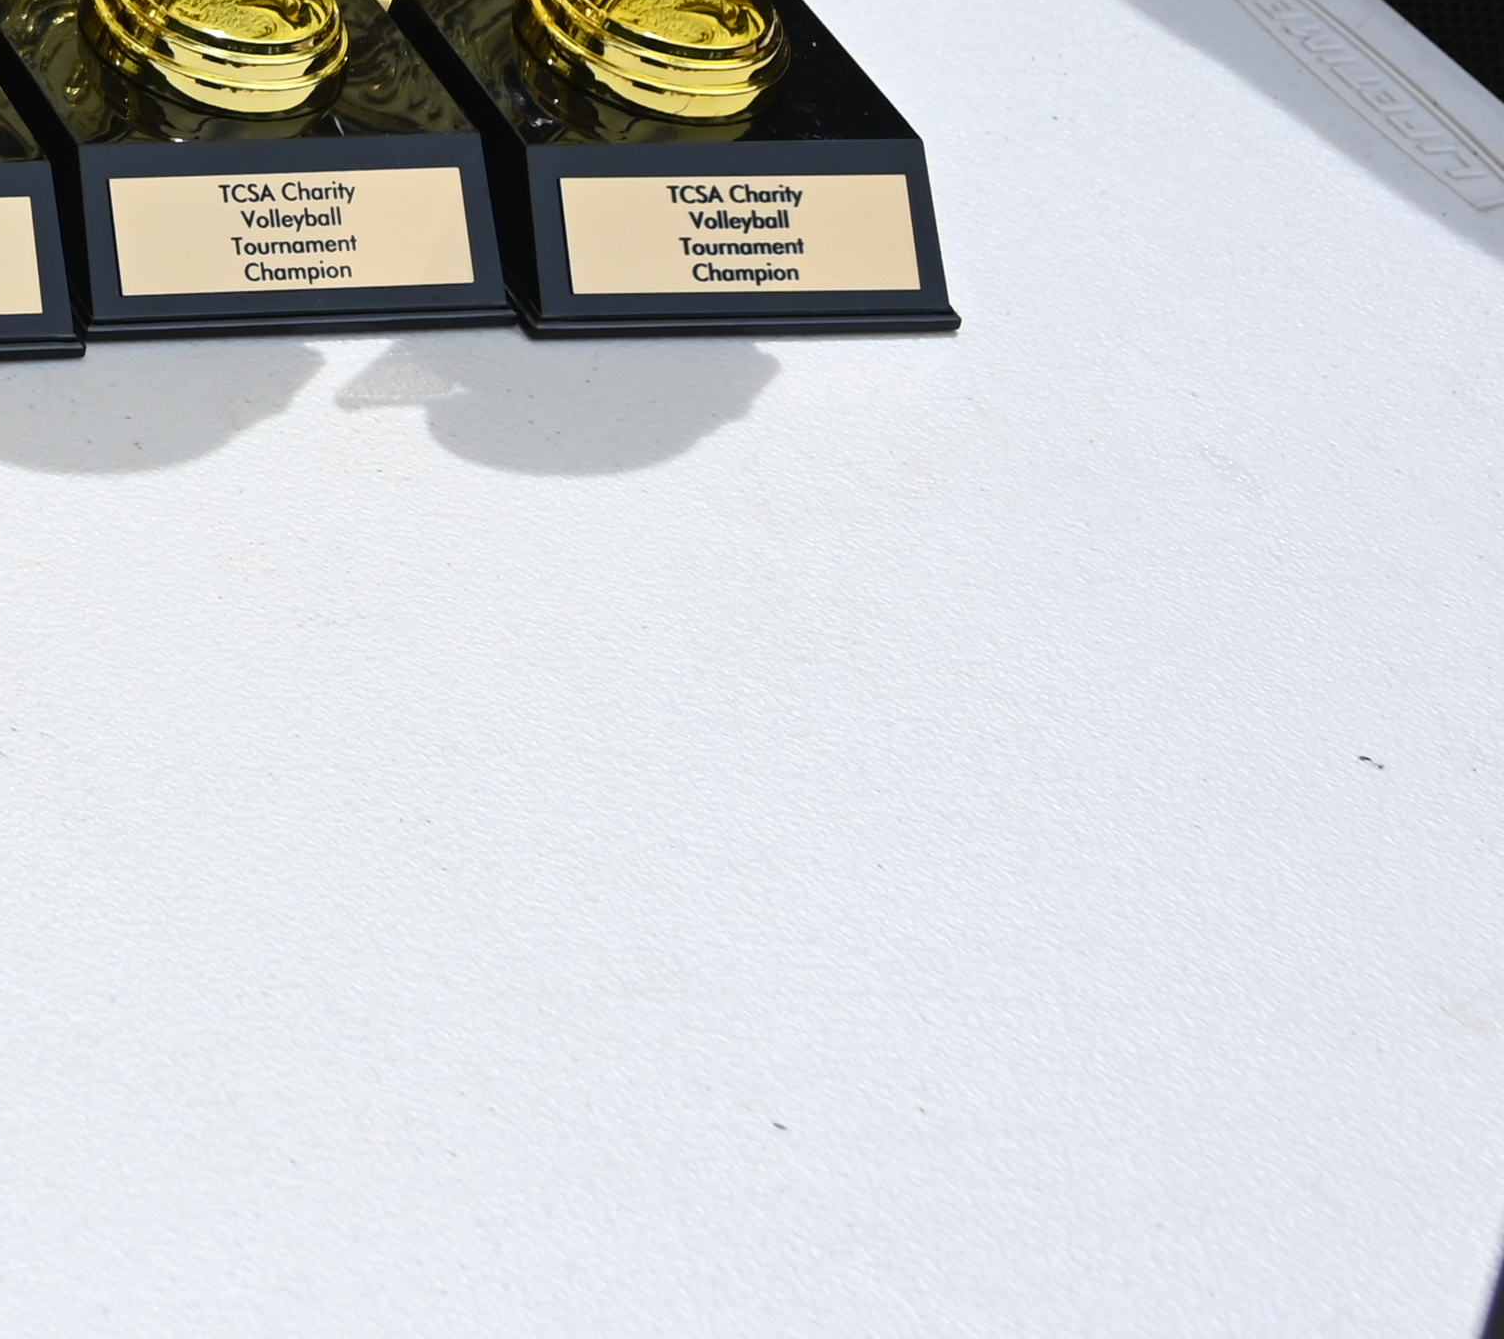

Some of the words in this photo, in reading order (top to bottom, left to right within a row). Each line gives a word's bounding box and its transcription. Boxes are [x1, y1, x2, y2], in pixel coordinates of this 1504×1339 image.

[218, 183, 276, 203] TCSA
[281, 180, 355, 204] Charity
[666, 184, 724, 204] TCSA
[728, 183, 803, 208] Charity
[240, 206, 342, 233] Volleyball
[688, 209, 790, 235] Volleyball
[230, 235, 357, 256] Tournament
[678, 237, 804, 256] Tournament
[244, 260, 352, 285] Champion
[692, 262, 800, 287] Champion
